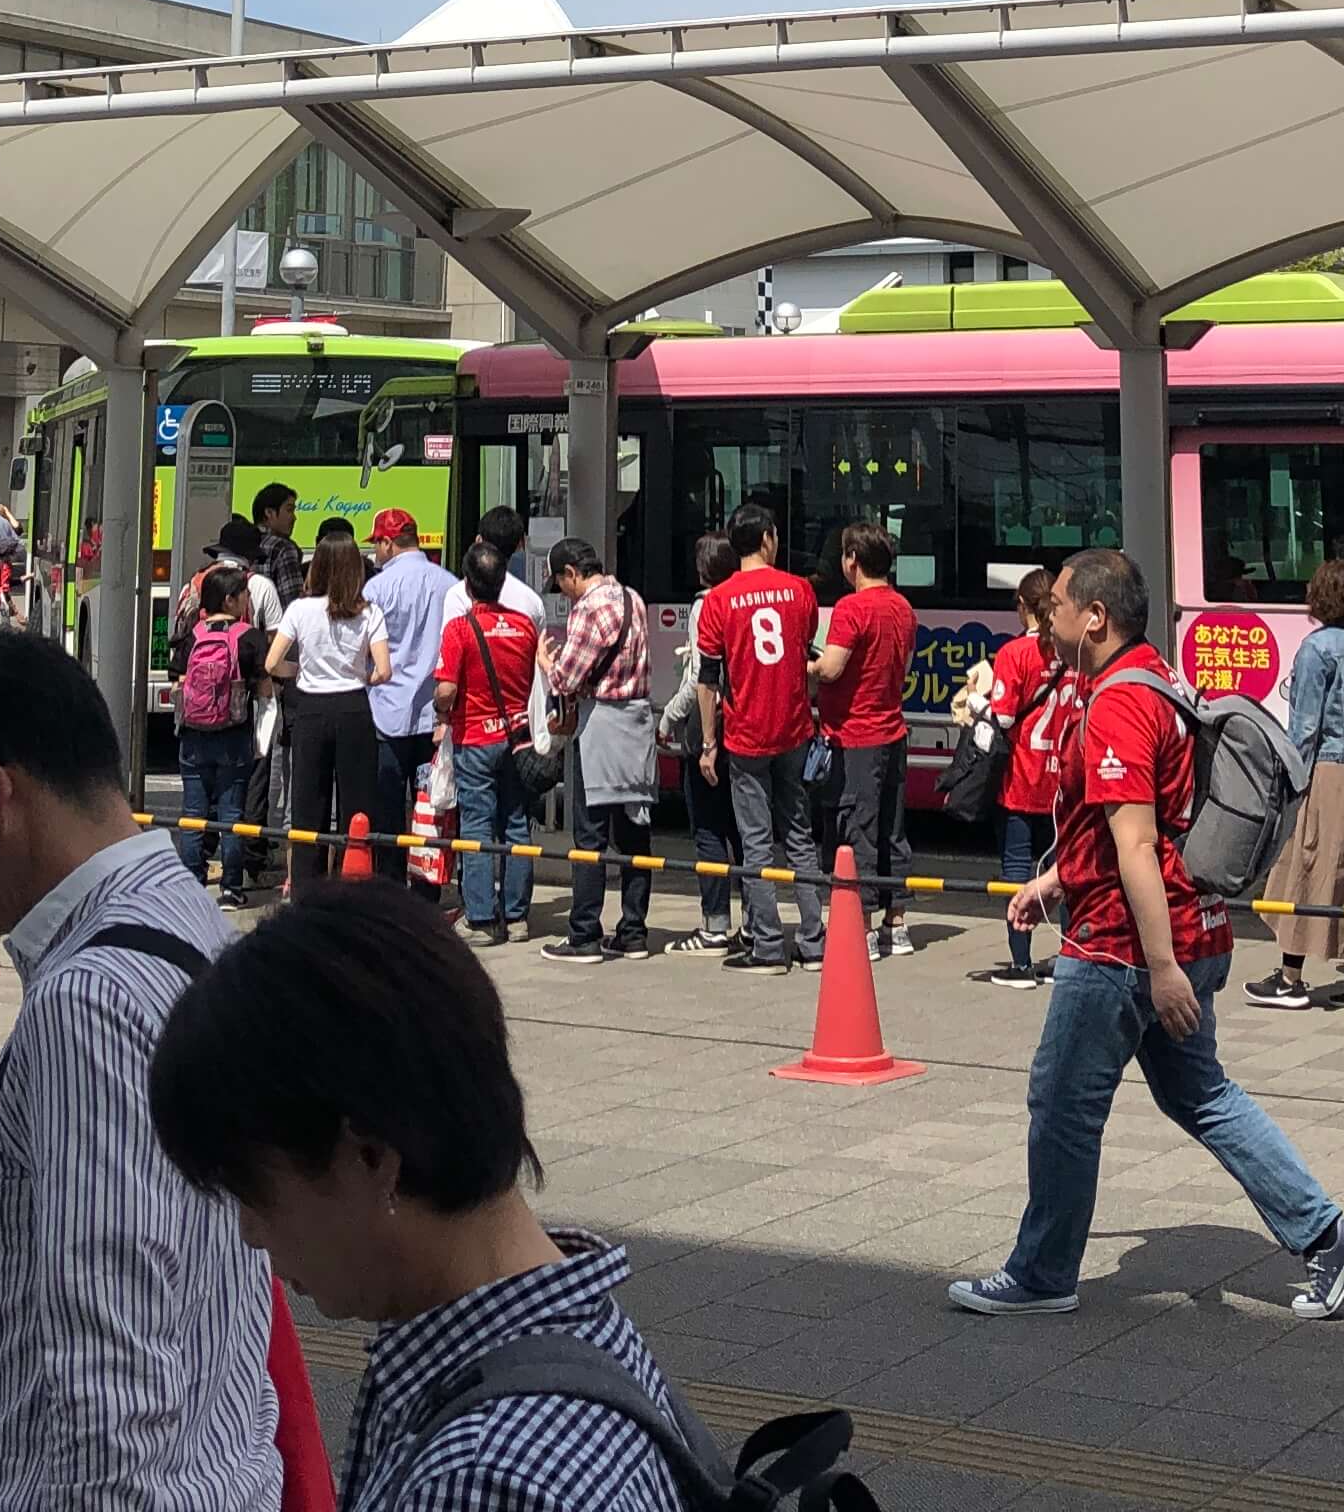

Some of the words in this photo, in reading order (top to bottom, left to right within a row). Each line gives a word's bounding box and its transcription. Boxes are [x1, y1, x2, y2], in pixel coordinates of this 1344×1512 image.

[294, 498, 318, 513] sai
[323, 494, 372, 517] Kogyo
[730, 588, 795, 609] KASHIWAGI
[678, 607, 689, 619] 出
[751, 607, 785, 666] 8
[1194, 624, 1267, 645] あなたの
[916, 640, 996, 668] イセリ
[1195, 647, 1270, 669] 元気生活
